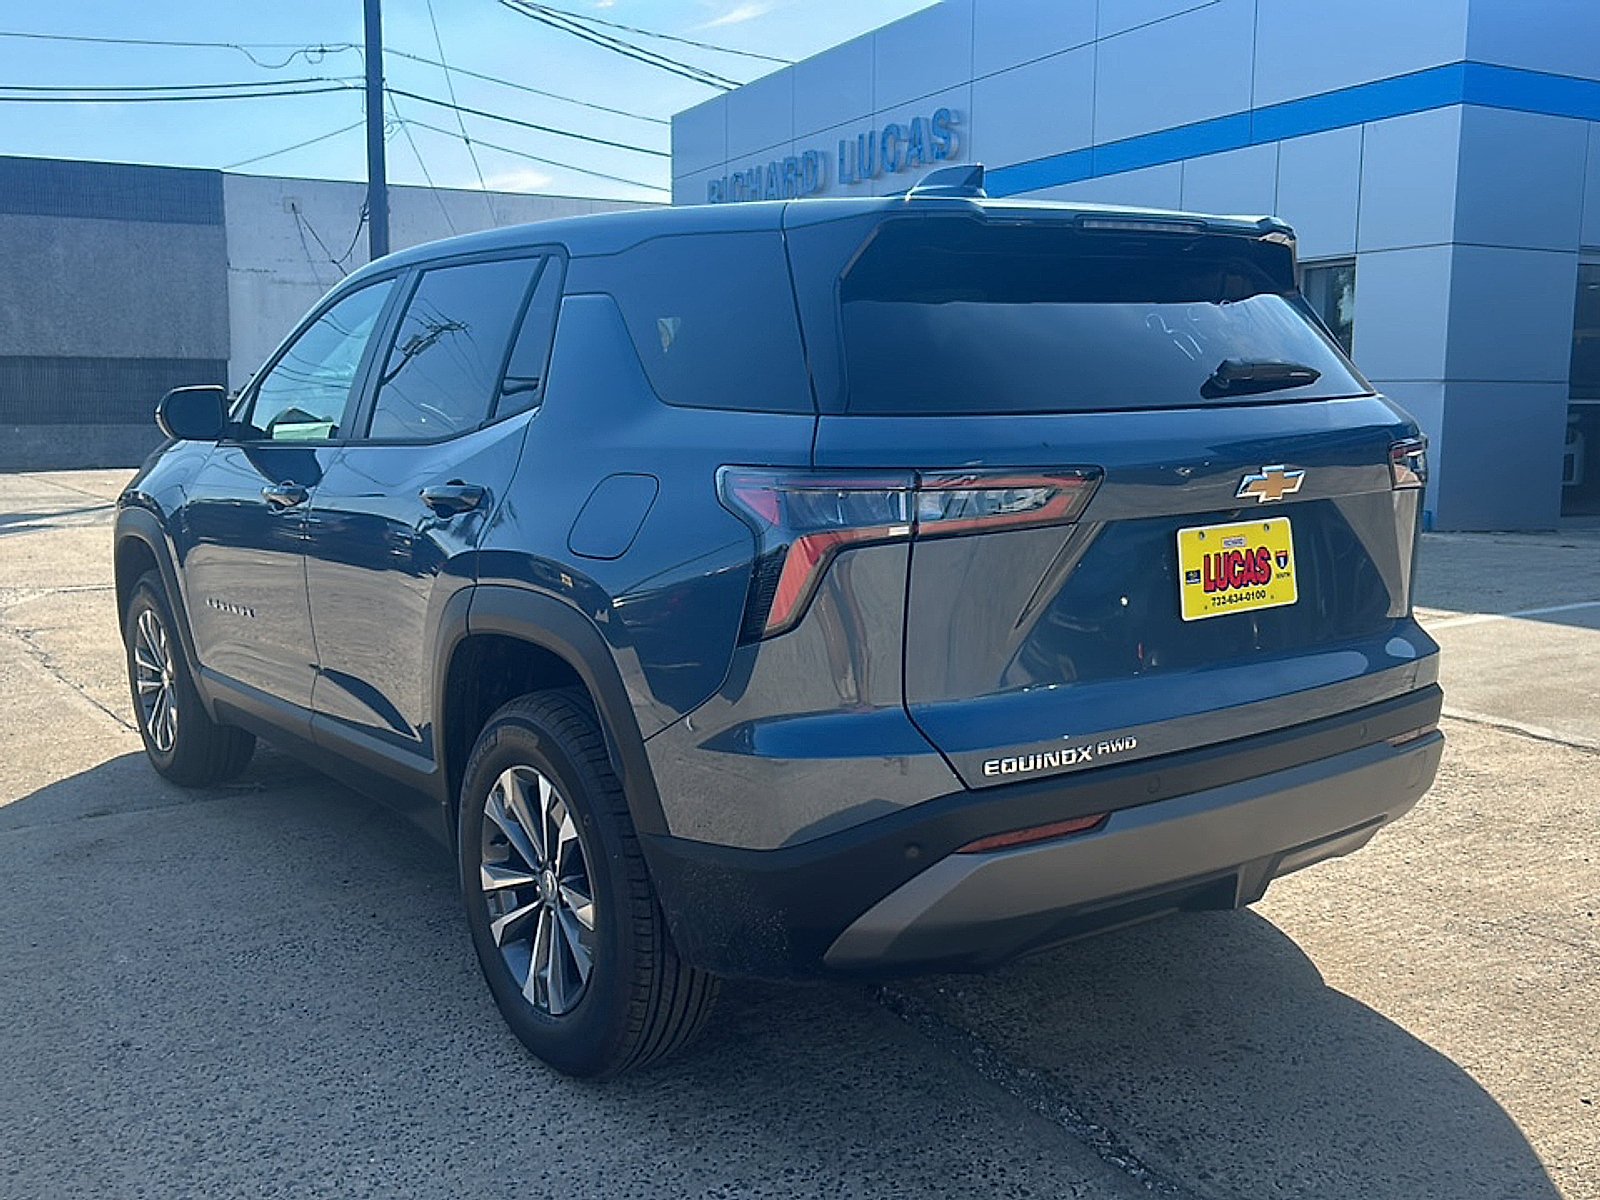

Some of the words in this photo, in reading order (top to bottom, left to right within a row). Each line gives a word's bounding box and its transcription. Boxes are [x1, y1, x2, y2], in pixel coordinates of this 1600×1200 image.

[707, 149, 821, 203] RICHARD
[839, 107, 959, 185] LUCAS
[1203, 546, 1272, 593] LUCAS
[1211, 589, 1266, 606] 732-634-0100
[984, 745, 1093, 777] EQUINOX
[1097, 736, 1138, 756] AWD
